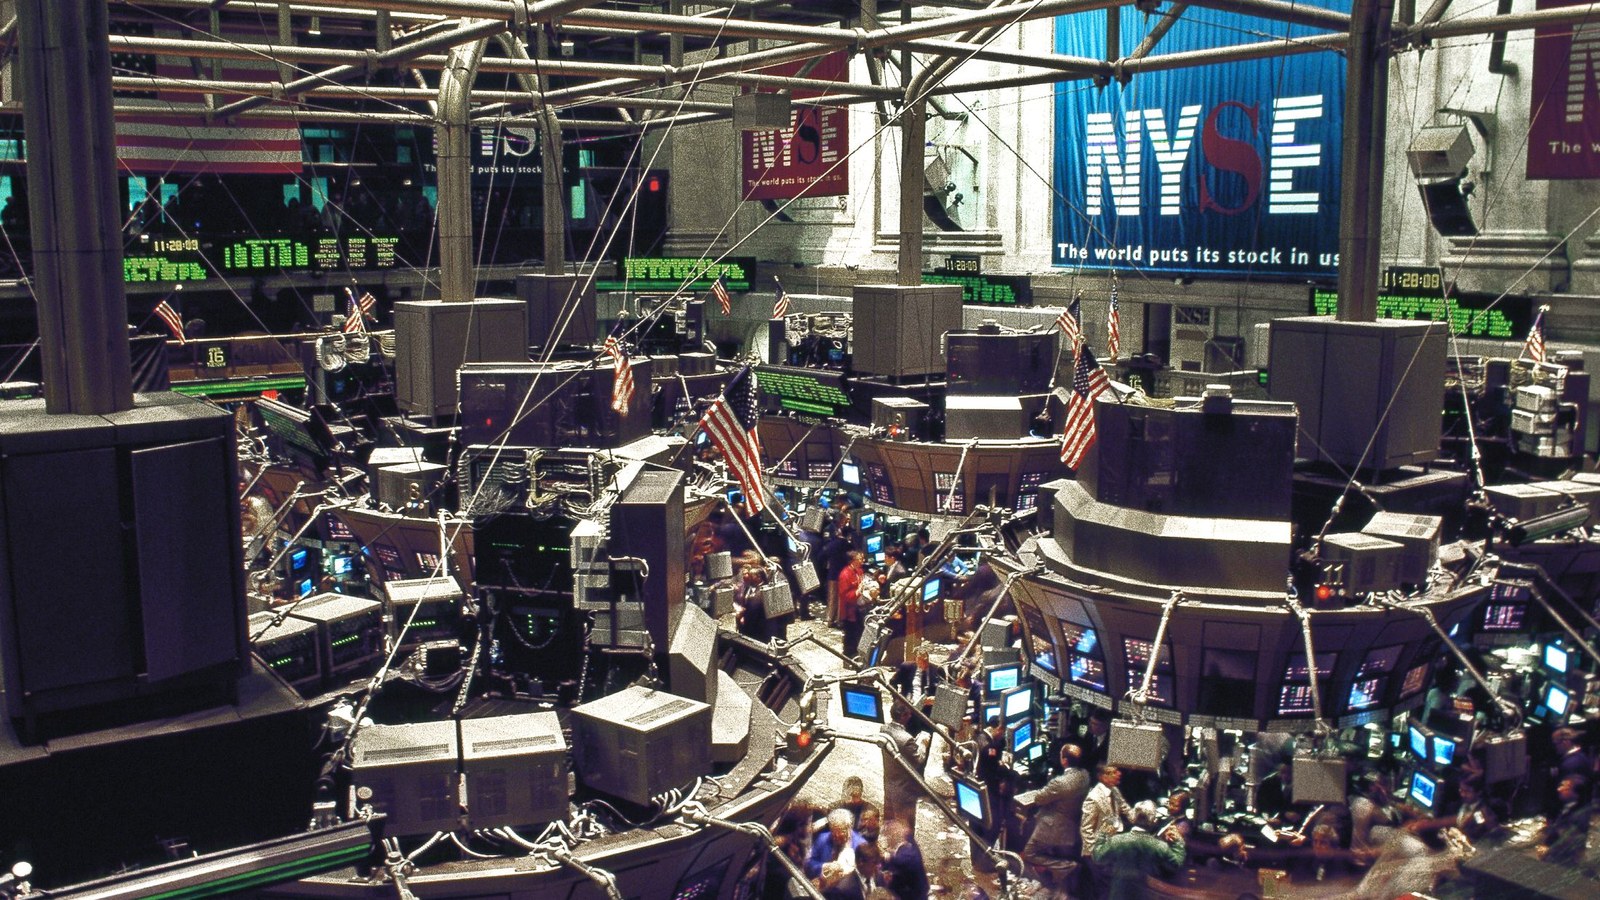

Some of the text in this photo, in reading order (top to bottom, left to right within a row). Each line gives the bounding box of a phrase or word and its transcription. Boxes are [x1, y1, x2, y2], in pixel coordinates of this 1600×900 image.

[752, 104, 838, 169] NYSE
[1548, 141, 1582, 154] The
[1086, 94, 1323, 216] NYSE
[478, 166, 499, 175] puts
[502, 165, 514, 173] its
[518, 165, 542, 173] stock
[761, 177, 780, 186] world
[781, 178, 795, 187] puts
[1058, 243, 1088, 259] The
[1095, 245, 1142, 261] world
[1150, 248, 1188, 266] puts
[1196, 246, 1220, 263] its
[1228, 247, 1281, 264] stock
[1291, 248, 1309, 265] in
[1384, 272, 1440, 288] 11:28:08
[208, 351, 224, 362] 16
